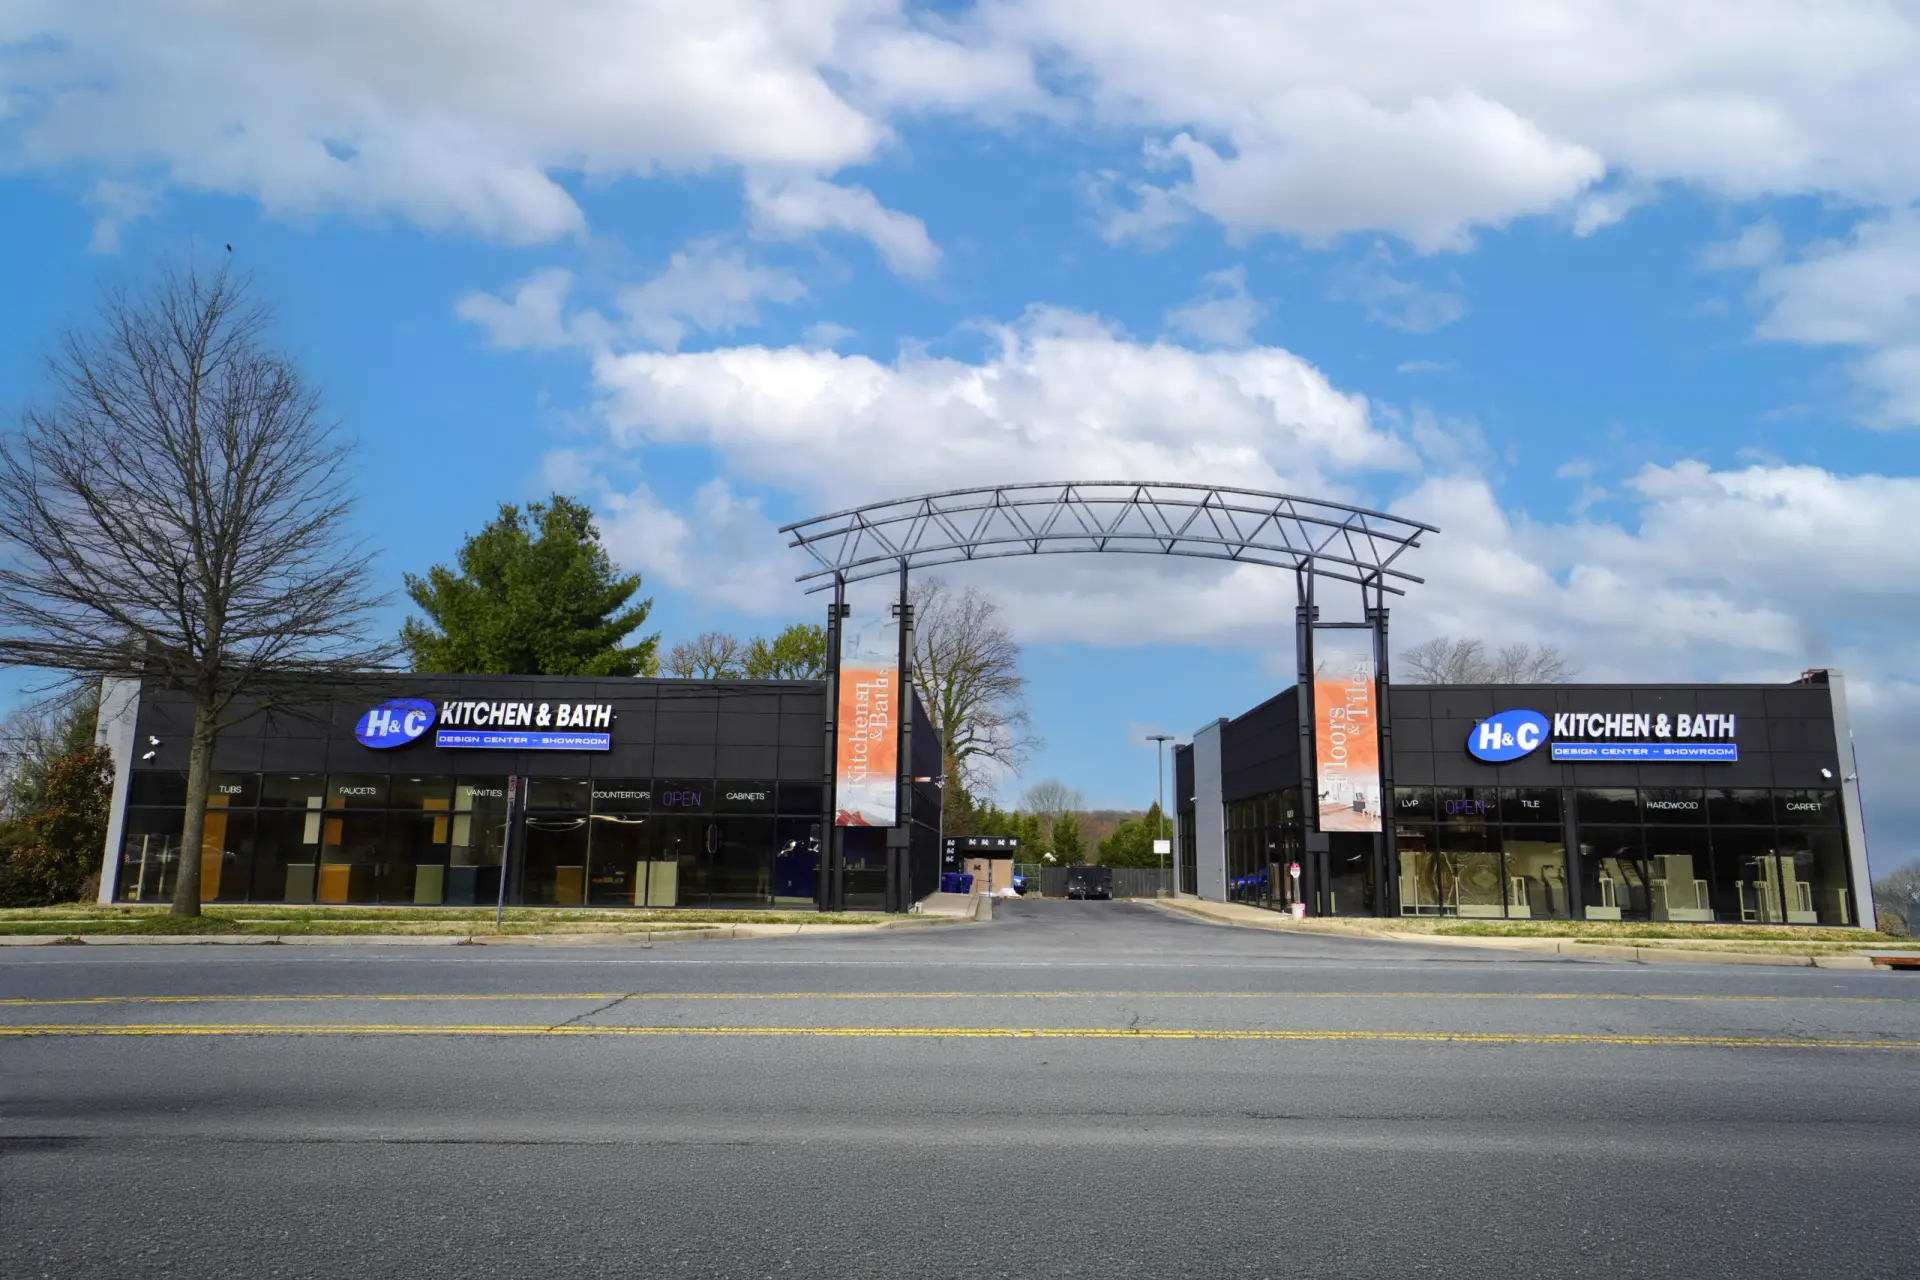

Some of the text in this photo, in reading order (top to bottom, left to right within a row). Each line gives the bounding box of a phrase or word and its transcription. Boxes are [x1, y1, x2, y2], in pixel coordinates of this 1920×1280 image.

[1345, 661, 1369, 736] & Tiles
[440, 701, 612, 728] KITCHEN & BATH
[365, 709, 427, 738] H&C
[1553, 712, 1735, 738] KITCHEN & BATH
[869, 728, 883, 742] &
[1479, 722, 1540, 751] H&C
[438, 735, 480, 744] DESIGN
[483, 736, 529, 744] CENTER
[541, 737, 608, 746] SHOWROOM
[1324, 707, 1348, 785] Floors
[1554, 747, 1598, 755] DESIGN
[1601, 747, 1649, 755] CENTER
[1663, 747, 1735, 756] SHOWROOM
[219, 785, 242, 794] TUBS
[339, 787, 377, 796] FAUCETS
[466, 788, 503, 798] VANITIES
[592, 790, 651, 799] COUNTERTOPS
[662, 790, 701, 808] OPEN
[726, 792, 765, 801] CABINETS
[1402, 799, 1419, 808] LVP
[1445, 799, 1486, 815] OPEN
[1521, 800, 1541, 809] TILE
[1646, 801, 1699, 810] HARDWOOD
[1786, 802, 1823, 812] CARPET
